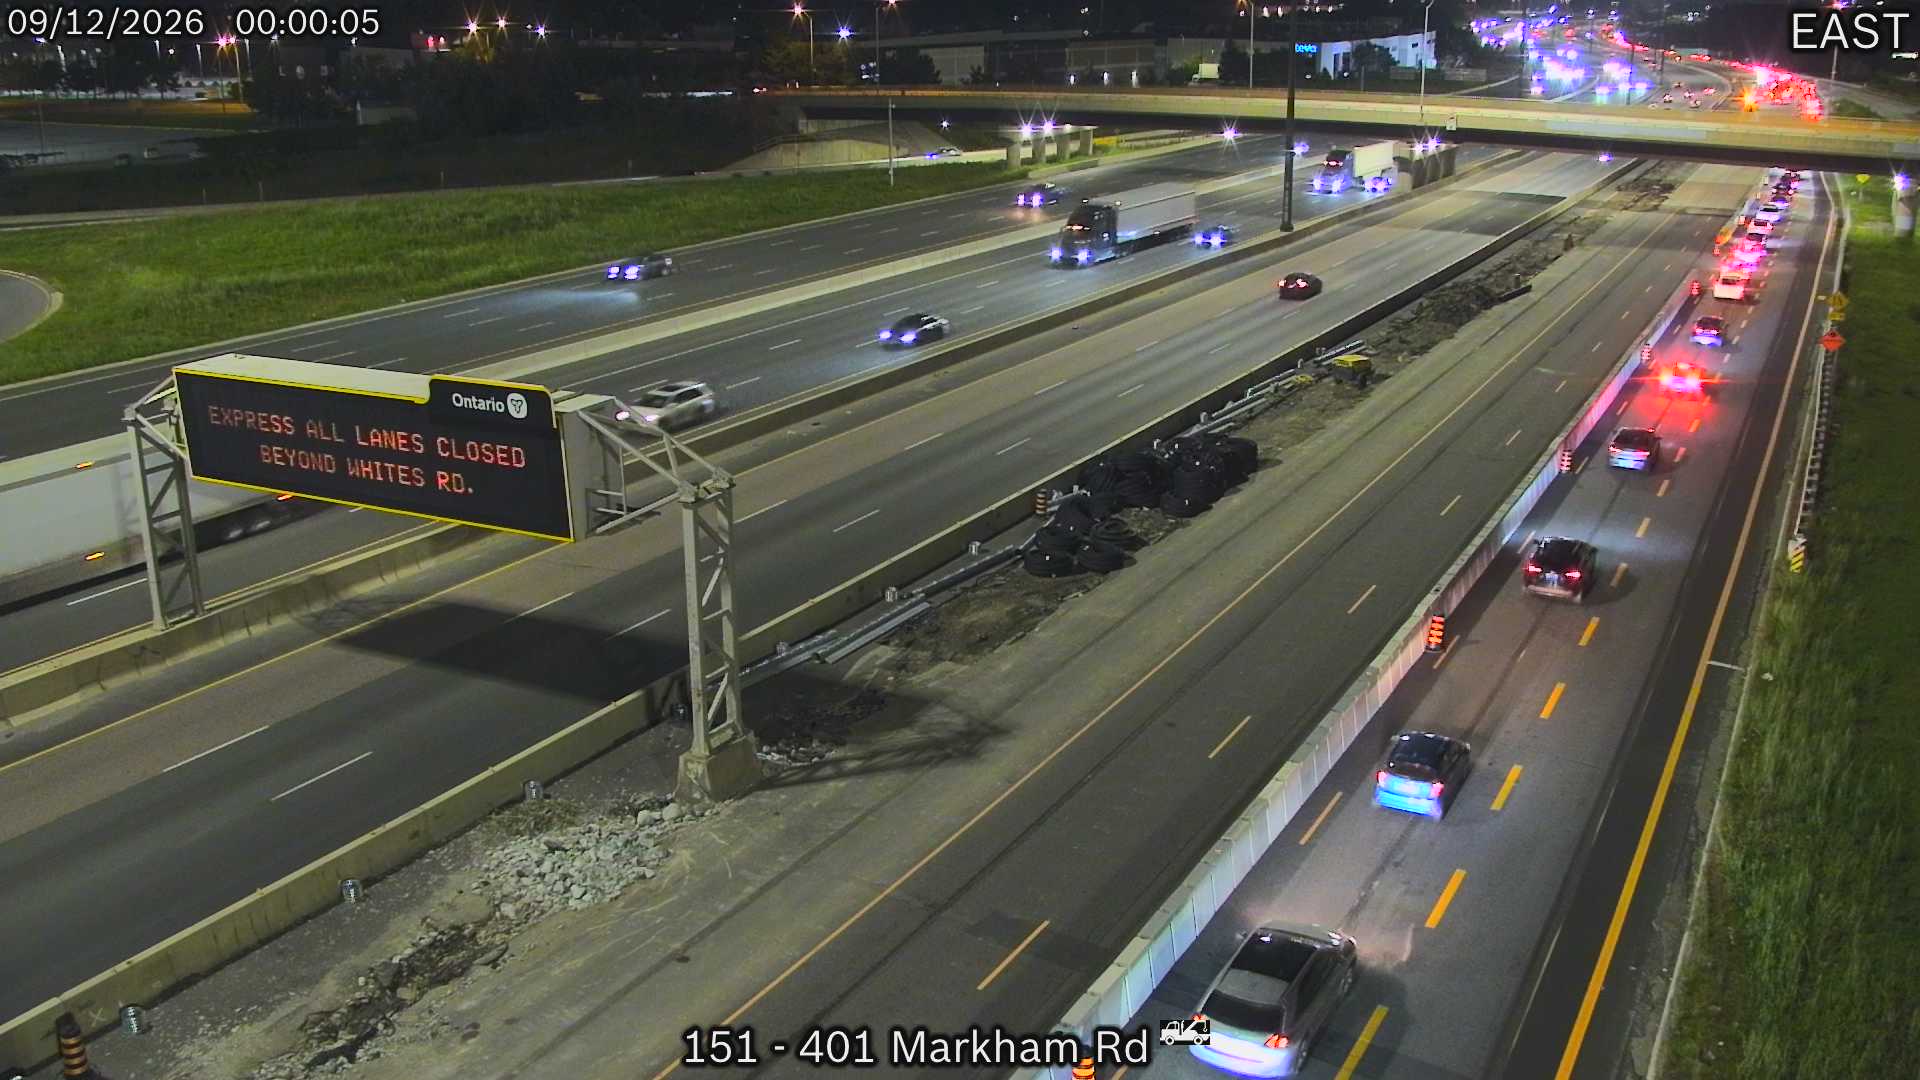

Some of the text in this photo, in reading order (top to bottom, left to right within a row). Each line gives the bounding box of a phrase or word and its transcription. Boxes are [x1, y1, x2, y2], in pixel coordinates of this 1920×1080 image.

[452, 392, 505, 413] Ontario
[208, 405, 526, 468] EXPRESS ALL LANES CLOSED
[260, 444, 474, 494] BEYOND WHITES RD.
